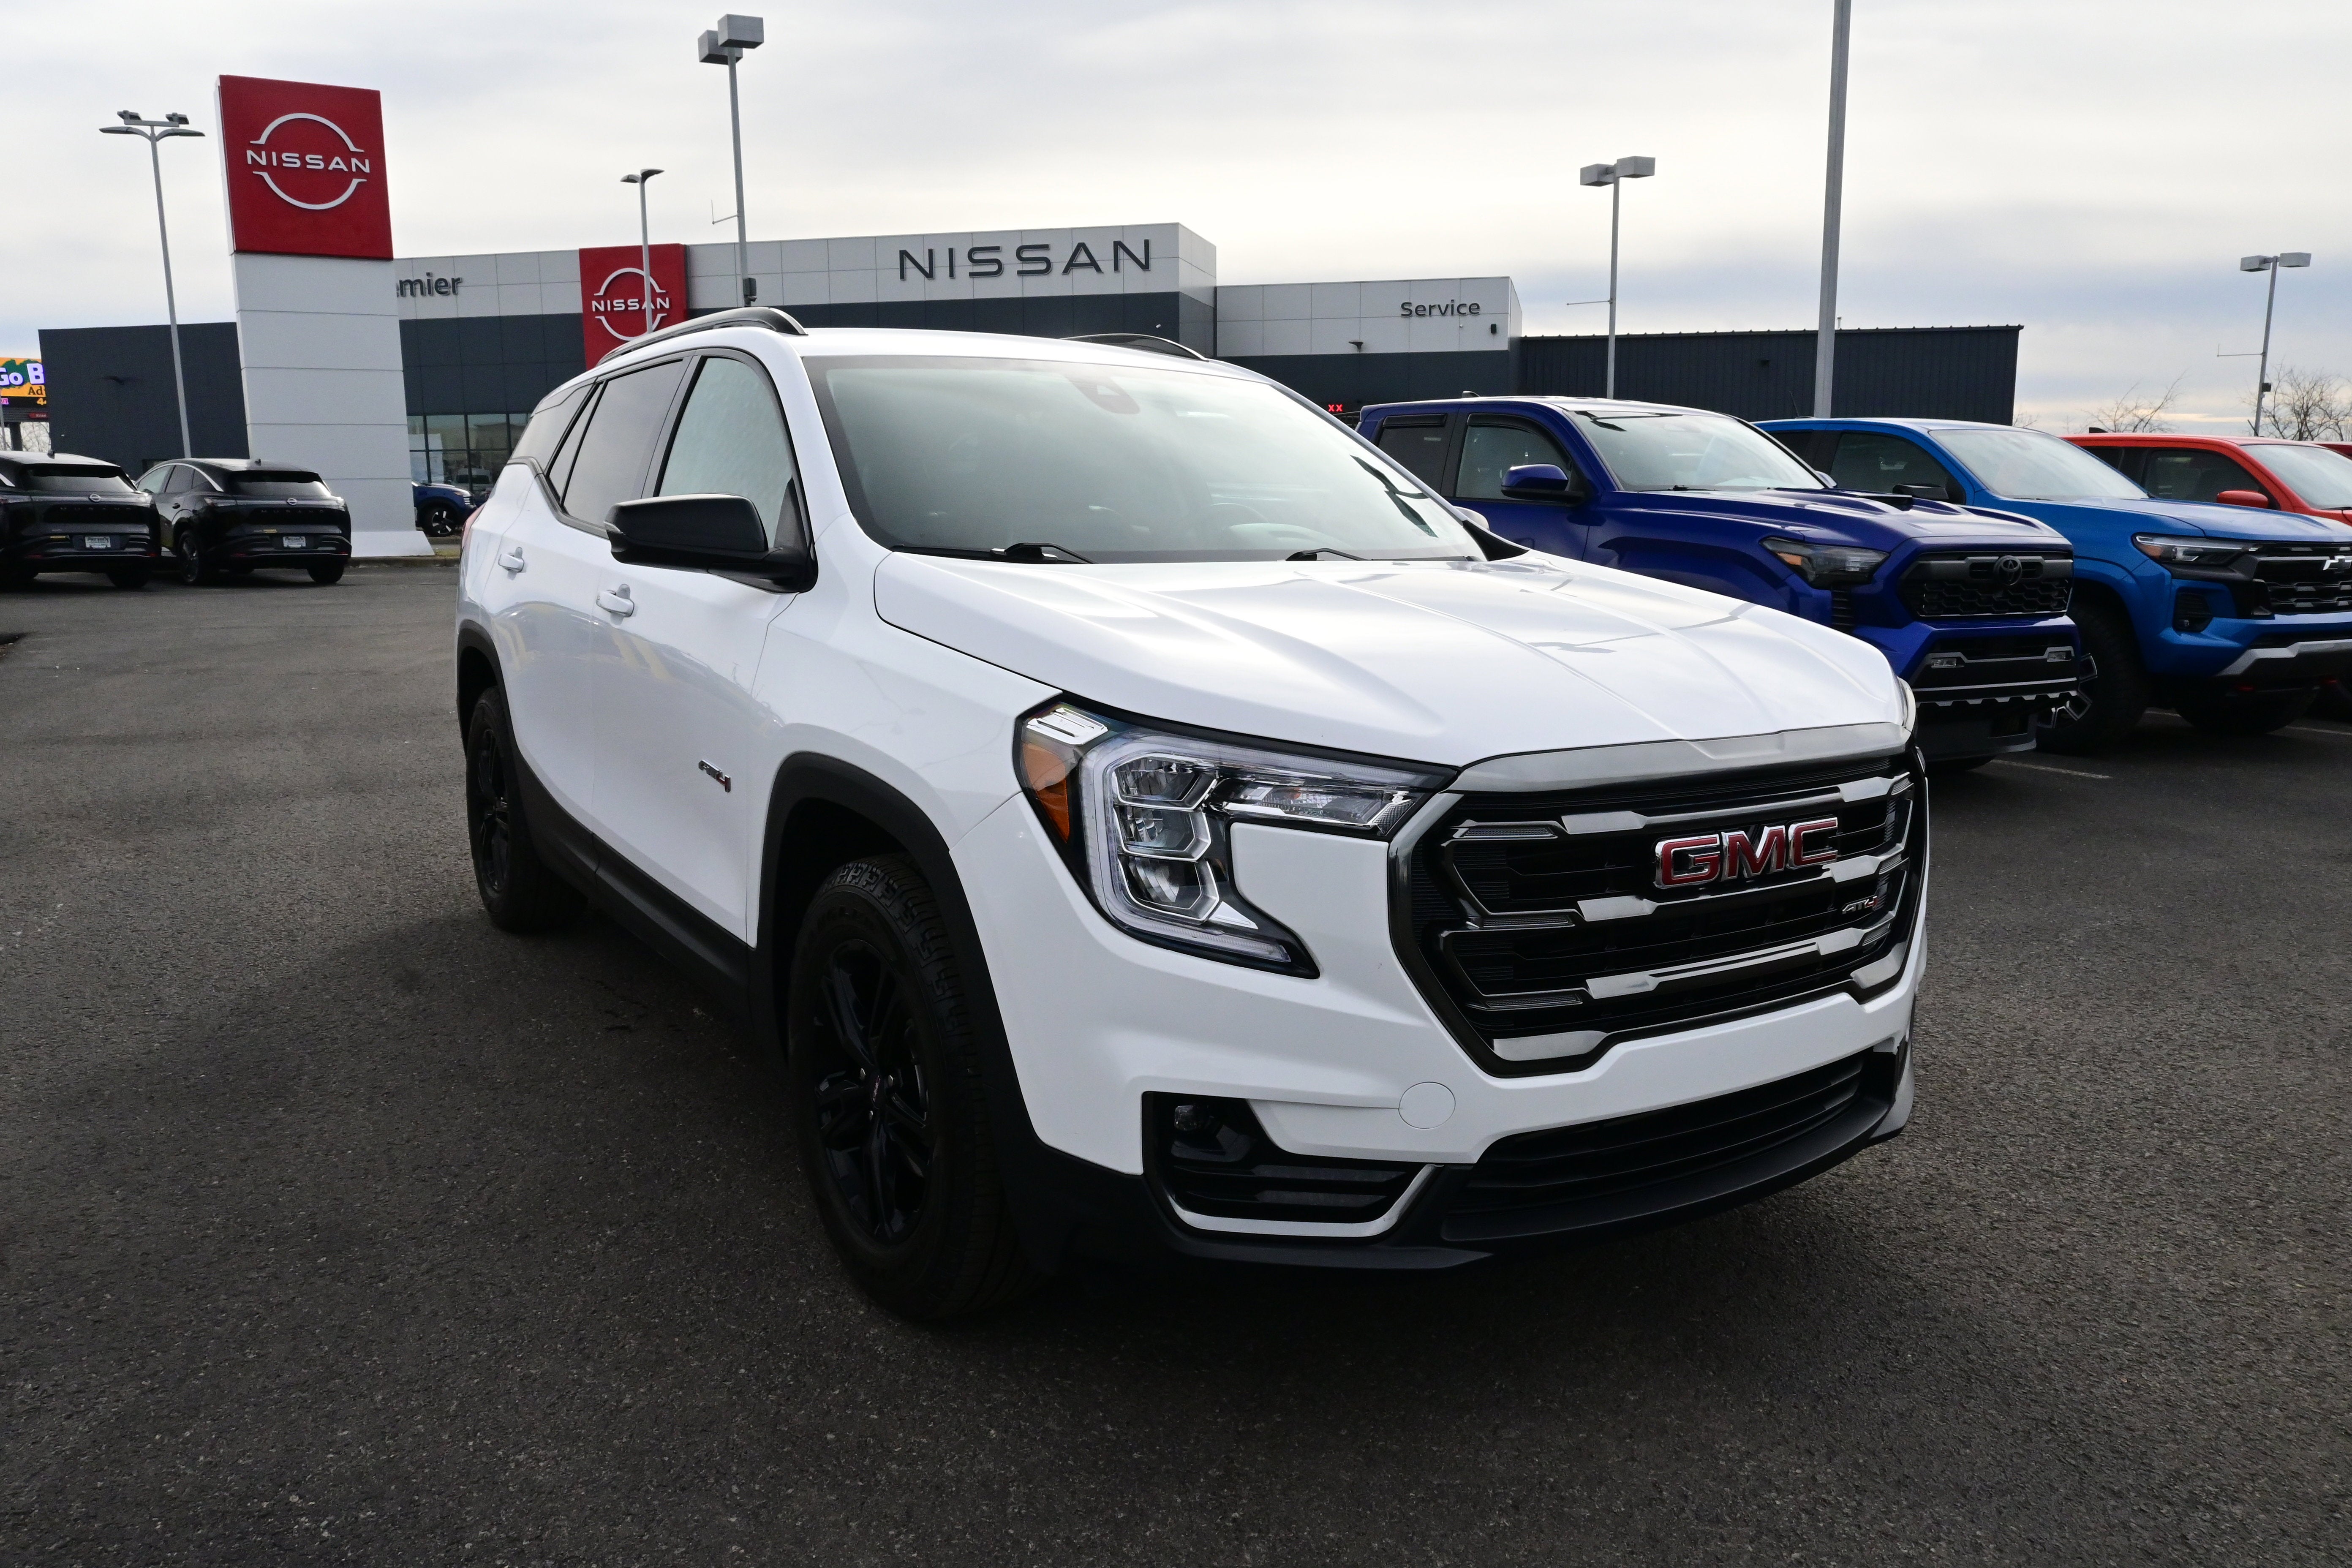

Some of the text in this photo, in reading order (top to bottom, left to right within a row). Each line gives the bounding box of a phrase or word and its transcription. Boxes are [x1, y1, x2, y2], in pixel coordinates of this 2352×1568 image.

[246, 150, 370, 173] NISSAN
[898, 239, 1151, 280] NISSAN
[396, 272, 463, 297] mier
[591, 297, 670, 312] NISSAN
[1400, 299, 1481, 317] Service
[1654, 817, 1838, 890] GMC
[1842, 896, 1878, 914] AT4
